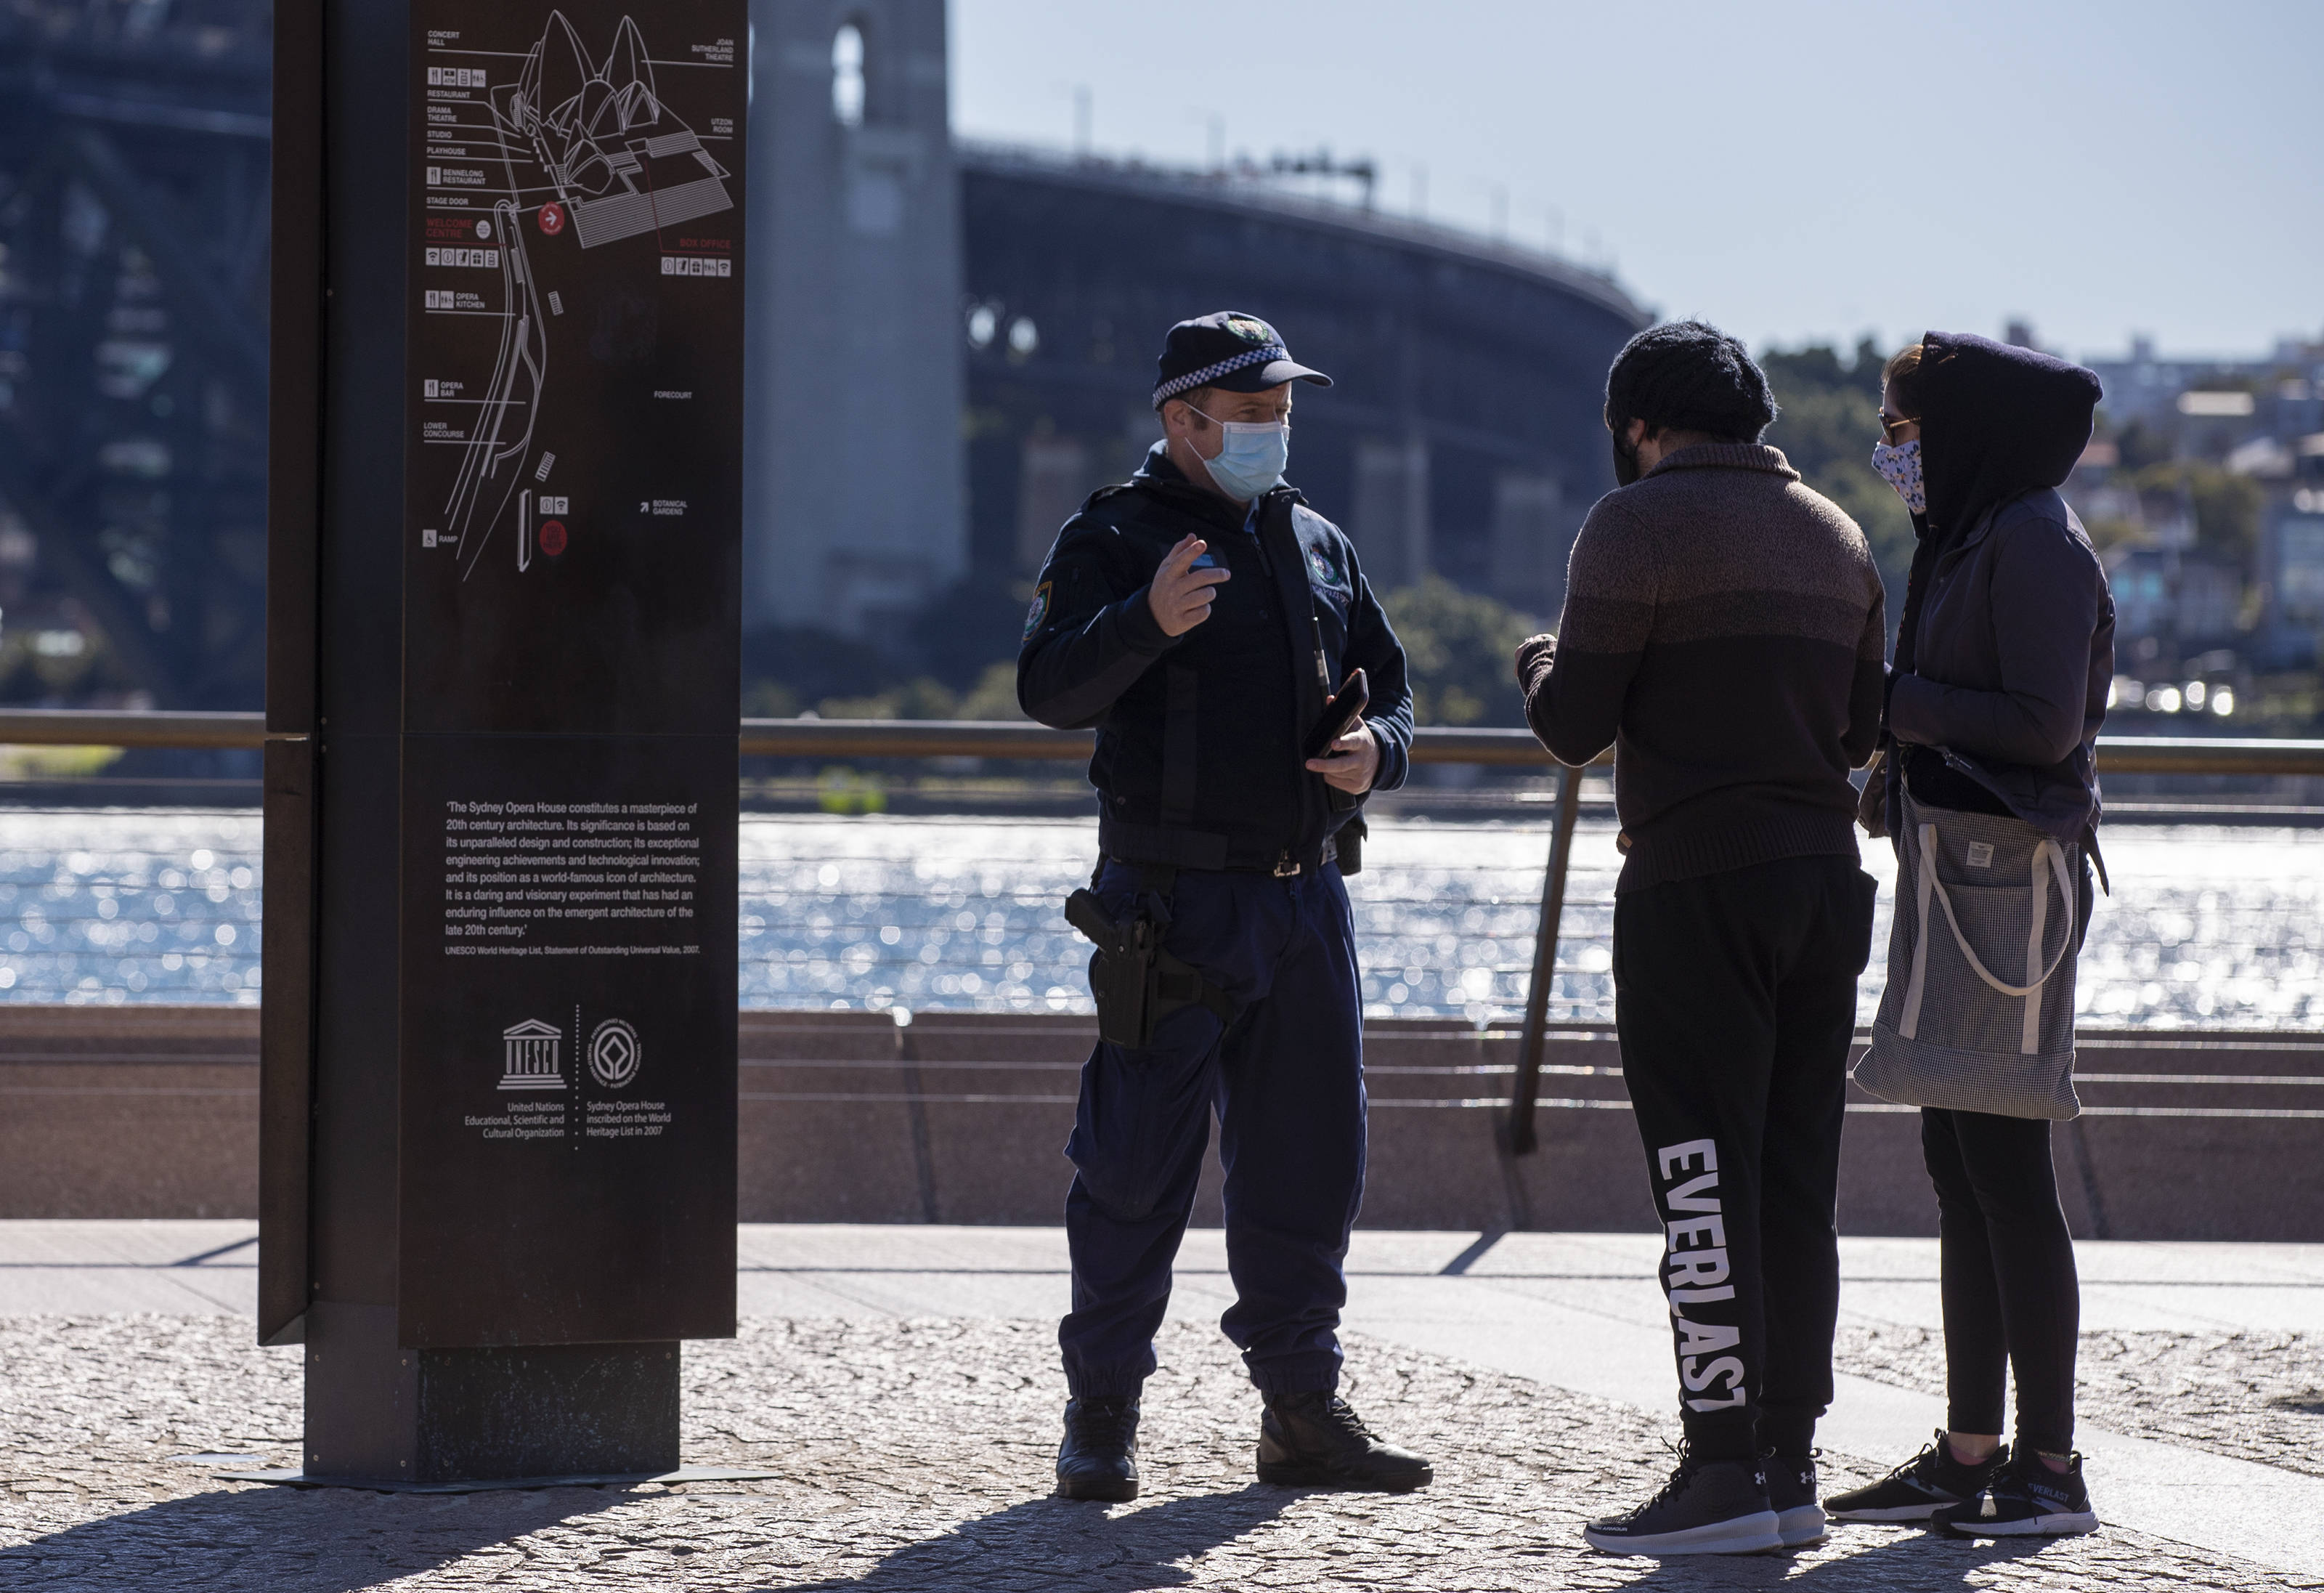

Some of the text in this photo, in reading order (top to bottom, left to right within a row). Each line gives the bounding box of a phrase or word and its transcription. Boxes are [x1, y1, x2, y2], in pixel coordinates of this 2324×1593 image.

[428, 31, 460, 39] CONCERT
[691, 45, 734, 54] SUTHERLAND
[427, 90, 471, 99] RESTAURANT
[427, 147, 466, 155] PLAYHOUSE
[443, 169, 484, 177] BENNELONG
[443, 176, 486, 185] RESTAURANT
[426, 218, 473, 229] WELCOME
[426, 228, 463, 238] CENTRE
[680, 238, 731, 249] BOX OFFICE
[456, 300, 485, 309] KITCHEN
[654, 391, 692, 400] FORECOURT
[469, 802, 504, 815] Sydney
[505, 802, 535, 814] Opera
[537, 803, 567, 813] House
[569, 803, 619, 814] constitutes
[630, 803, 686, 816] masterpiece
[687, 803, 697, 814] of
[446, 819, 468, 830] 20th
[469, 820, 505, 833] century
[506, 819, 564, 830] architecture.
[566, 820, 579, 831] Its
[580, 820, 635, 833] significance
[637, 821, 646, 831] is
[647, 821, 675, 831] based
[446, 837, 699, 851] its unparalleled design and construction; its exceptional
[445, 854, 700, 868] engineering achievements and technological innovation;
[445, 872, 464, 883] and
[466, 872, 478, 883] its
[479, 872, 517, 885] position
[519, 874, 531, 883] as
[541, 872, 604, 883] world-famous
[606, 872, 626, 883] icon
[627, 872, 638, 883] of
[639, 872, 696, 883] architecture.
[446, 890, 452, 900] It
[455, 890, 463, 900] is
[473, 890, 503, 903] daring
[505, 890, 524, 900] and
[525, 890, 567, 903] visionary
[569, 890, 620, 902] experiment
[622, 890, 641, 900] that
[643, 890, 659, 900] has
[662, 890, 679, 900] had
[445, 907, 487, 920] enduring
[489, 907, 532, 918] influence
[547, 907, 563, 917] the
[564, 908, 609, 920] emergent
[610, 907, 665, 917] architecture
[667, 907, 677, 917] of
[678, 907, 694, 917] the
[445, 925, 463, 936] late
[465, 925, 486, 936] 20th
[506, 1040, 559, 1074] UNESCO
[508, 1102, 565, 1112] United Nations
[587, 1100, 665, 1113] Sydney Opera House
[465, 1114, 565, 1126] Educational, Scientific and
[587, 1114, 621, 1124] inscribed
[634, 1114, 647, 1123] the
[648, 1113, 671, 1123] World
[483, 1127, 565, 1140] Cultural Organization
[587, 1126, 663, 1138] Heritage List in 2007
